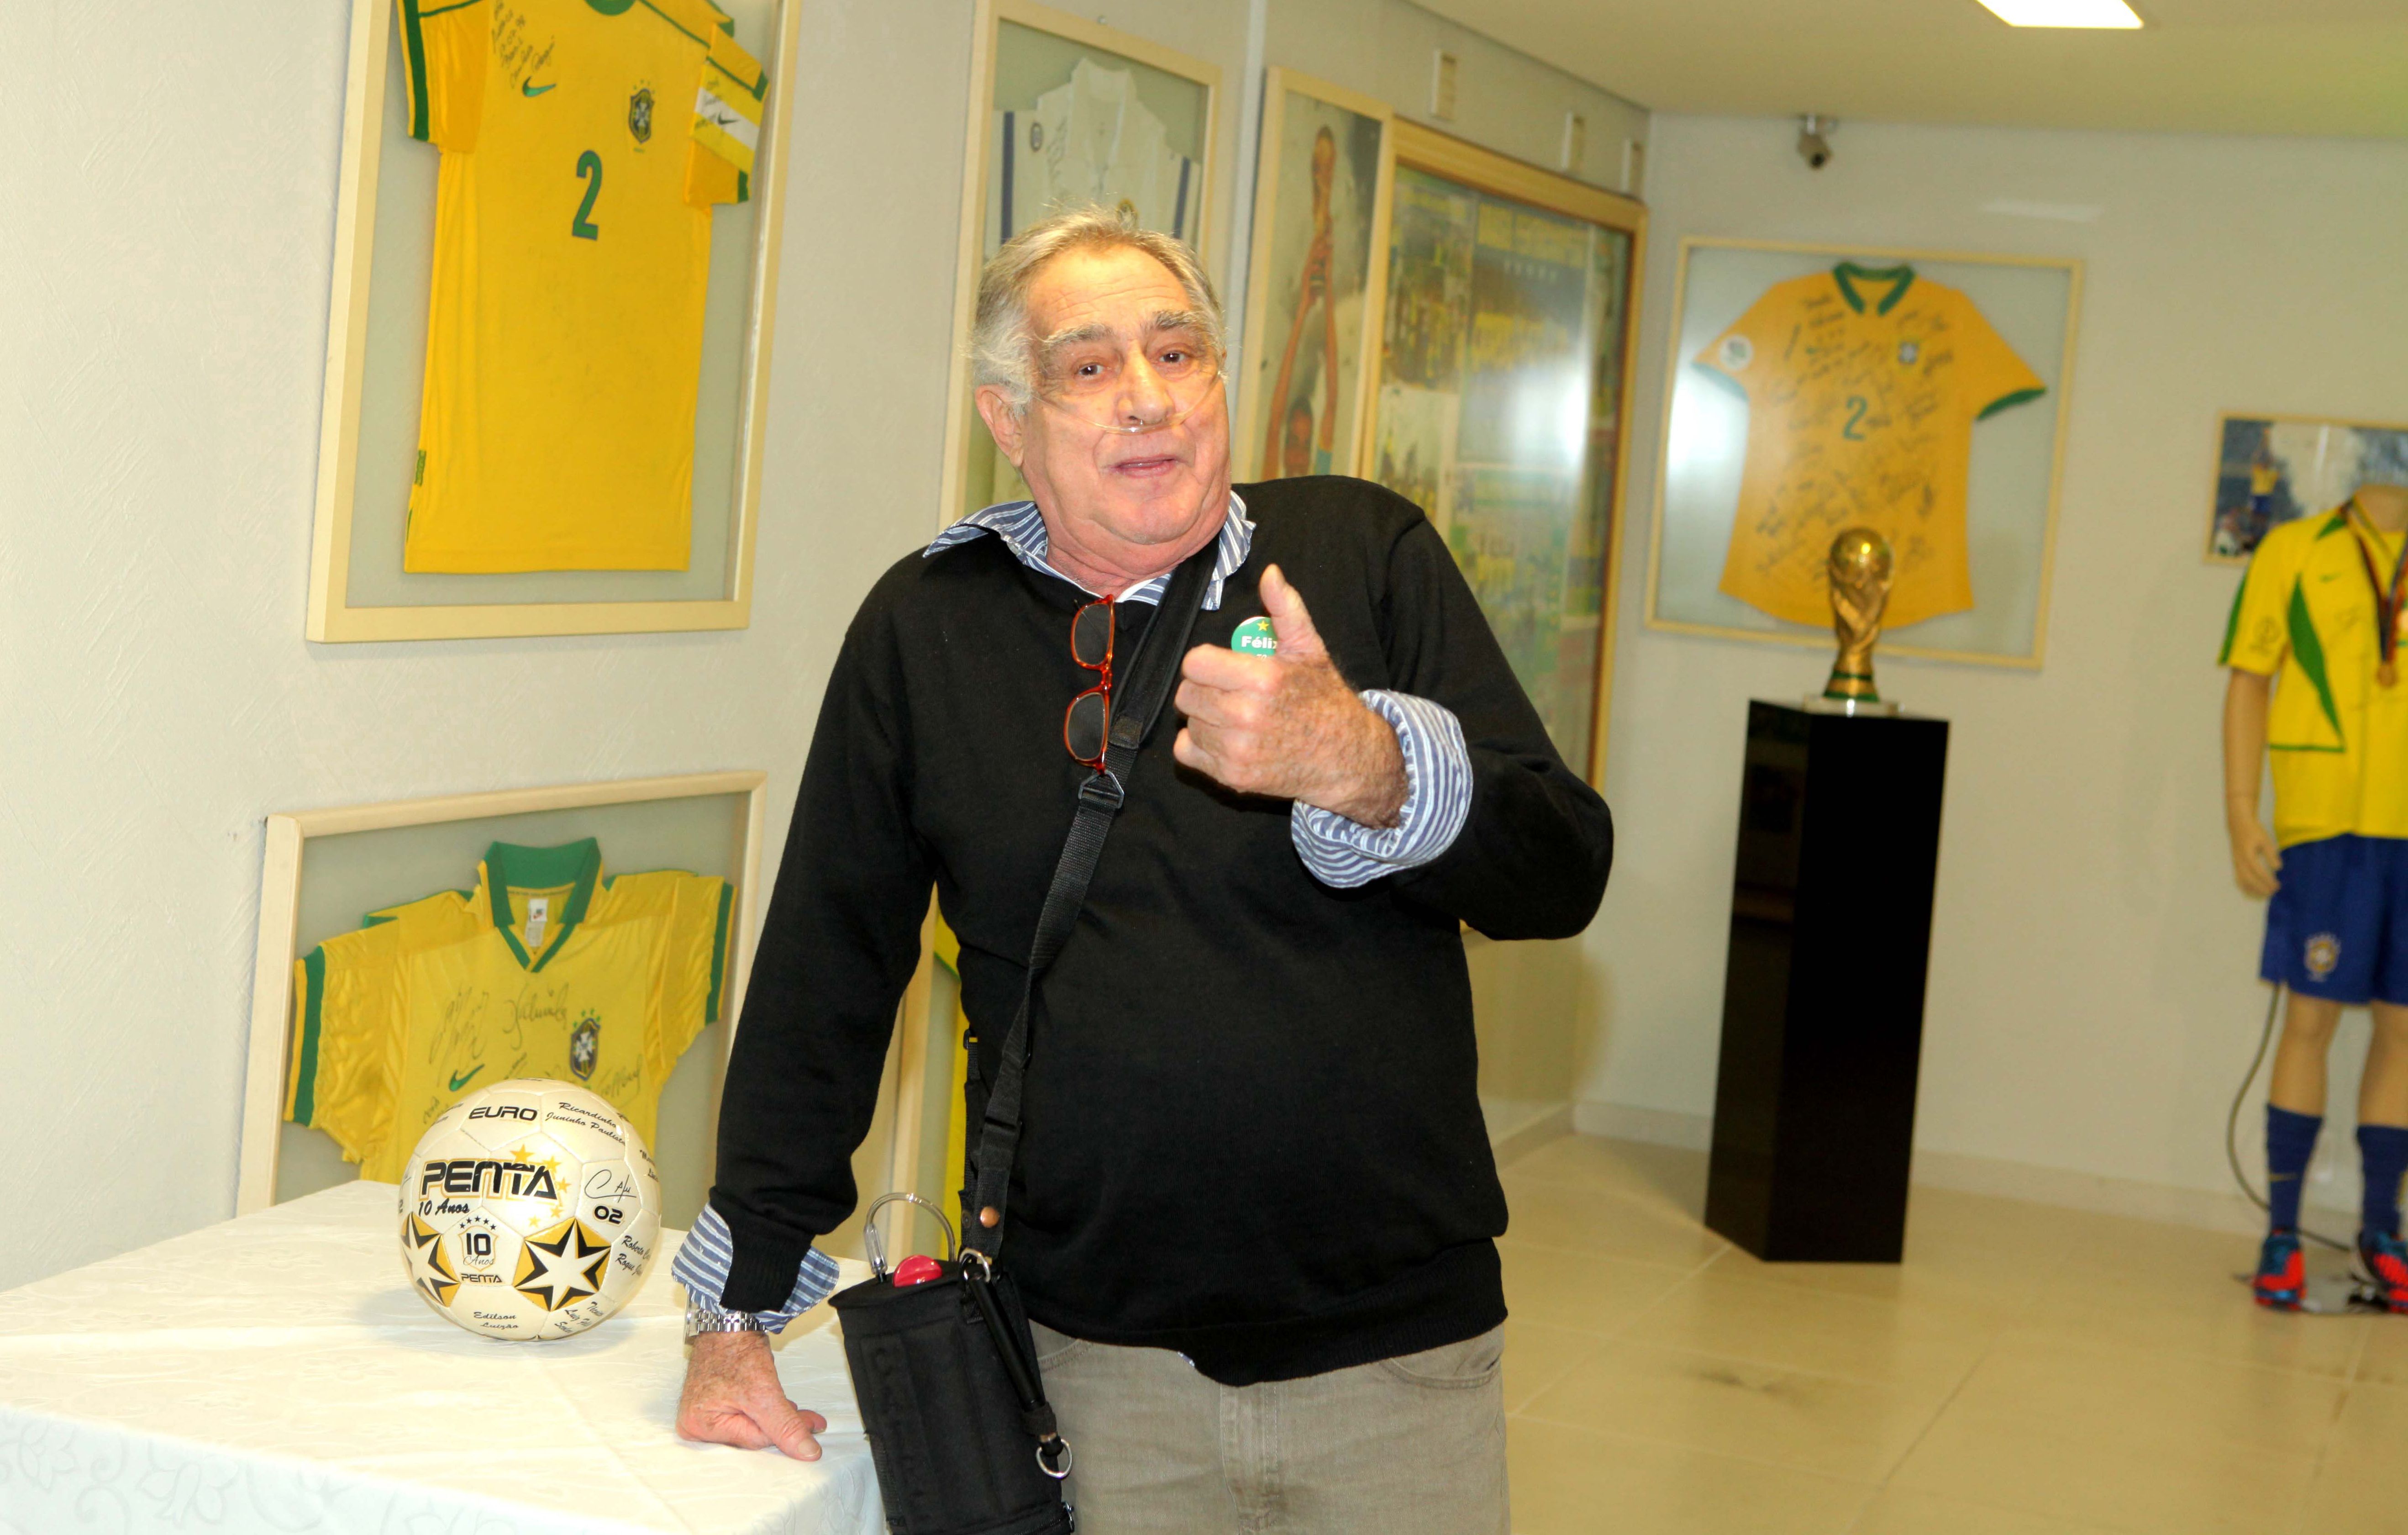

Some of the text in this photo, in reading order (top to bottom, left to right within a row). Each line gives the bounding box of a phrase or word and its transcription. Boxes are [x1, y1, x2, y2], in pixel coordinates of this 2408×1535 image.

[572, 150, 602, 241] 2
[1843, 396, 1868, 440] 2
[468, 1106, 538, 1121] EURO
[545, 1113, 586, 1126] Juninho
[558, 1102, 616, 1128] Ricardinho
[421, 1160, 557, 1200] PENTA
[418, 1197, 470, 1217] 10 Anos
[594, 1205, 623, 1224] 02
[466, 1233, 491, 1256] 10
[461, 1273, 503, 1283] PENTA
